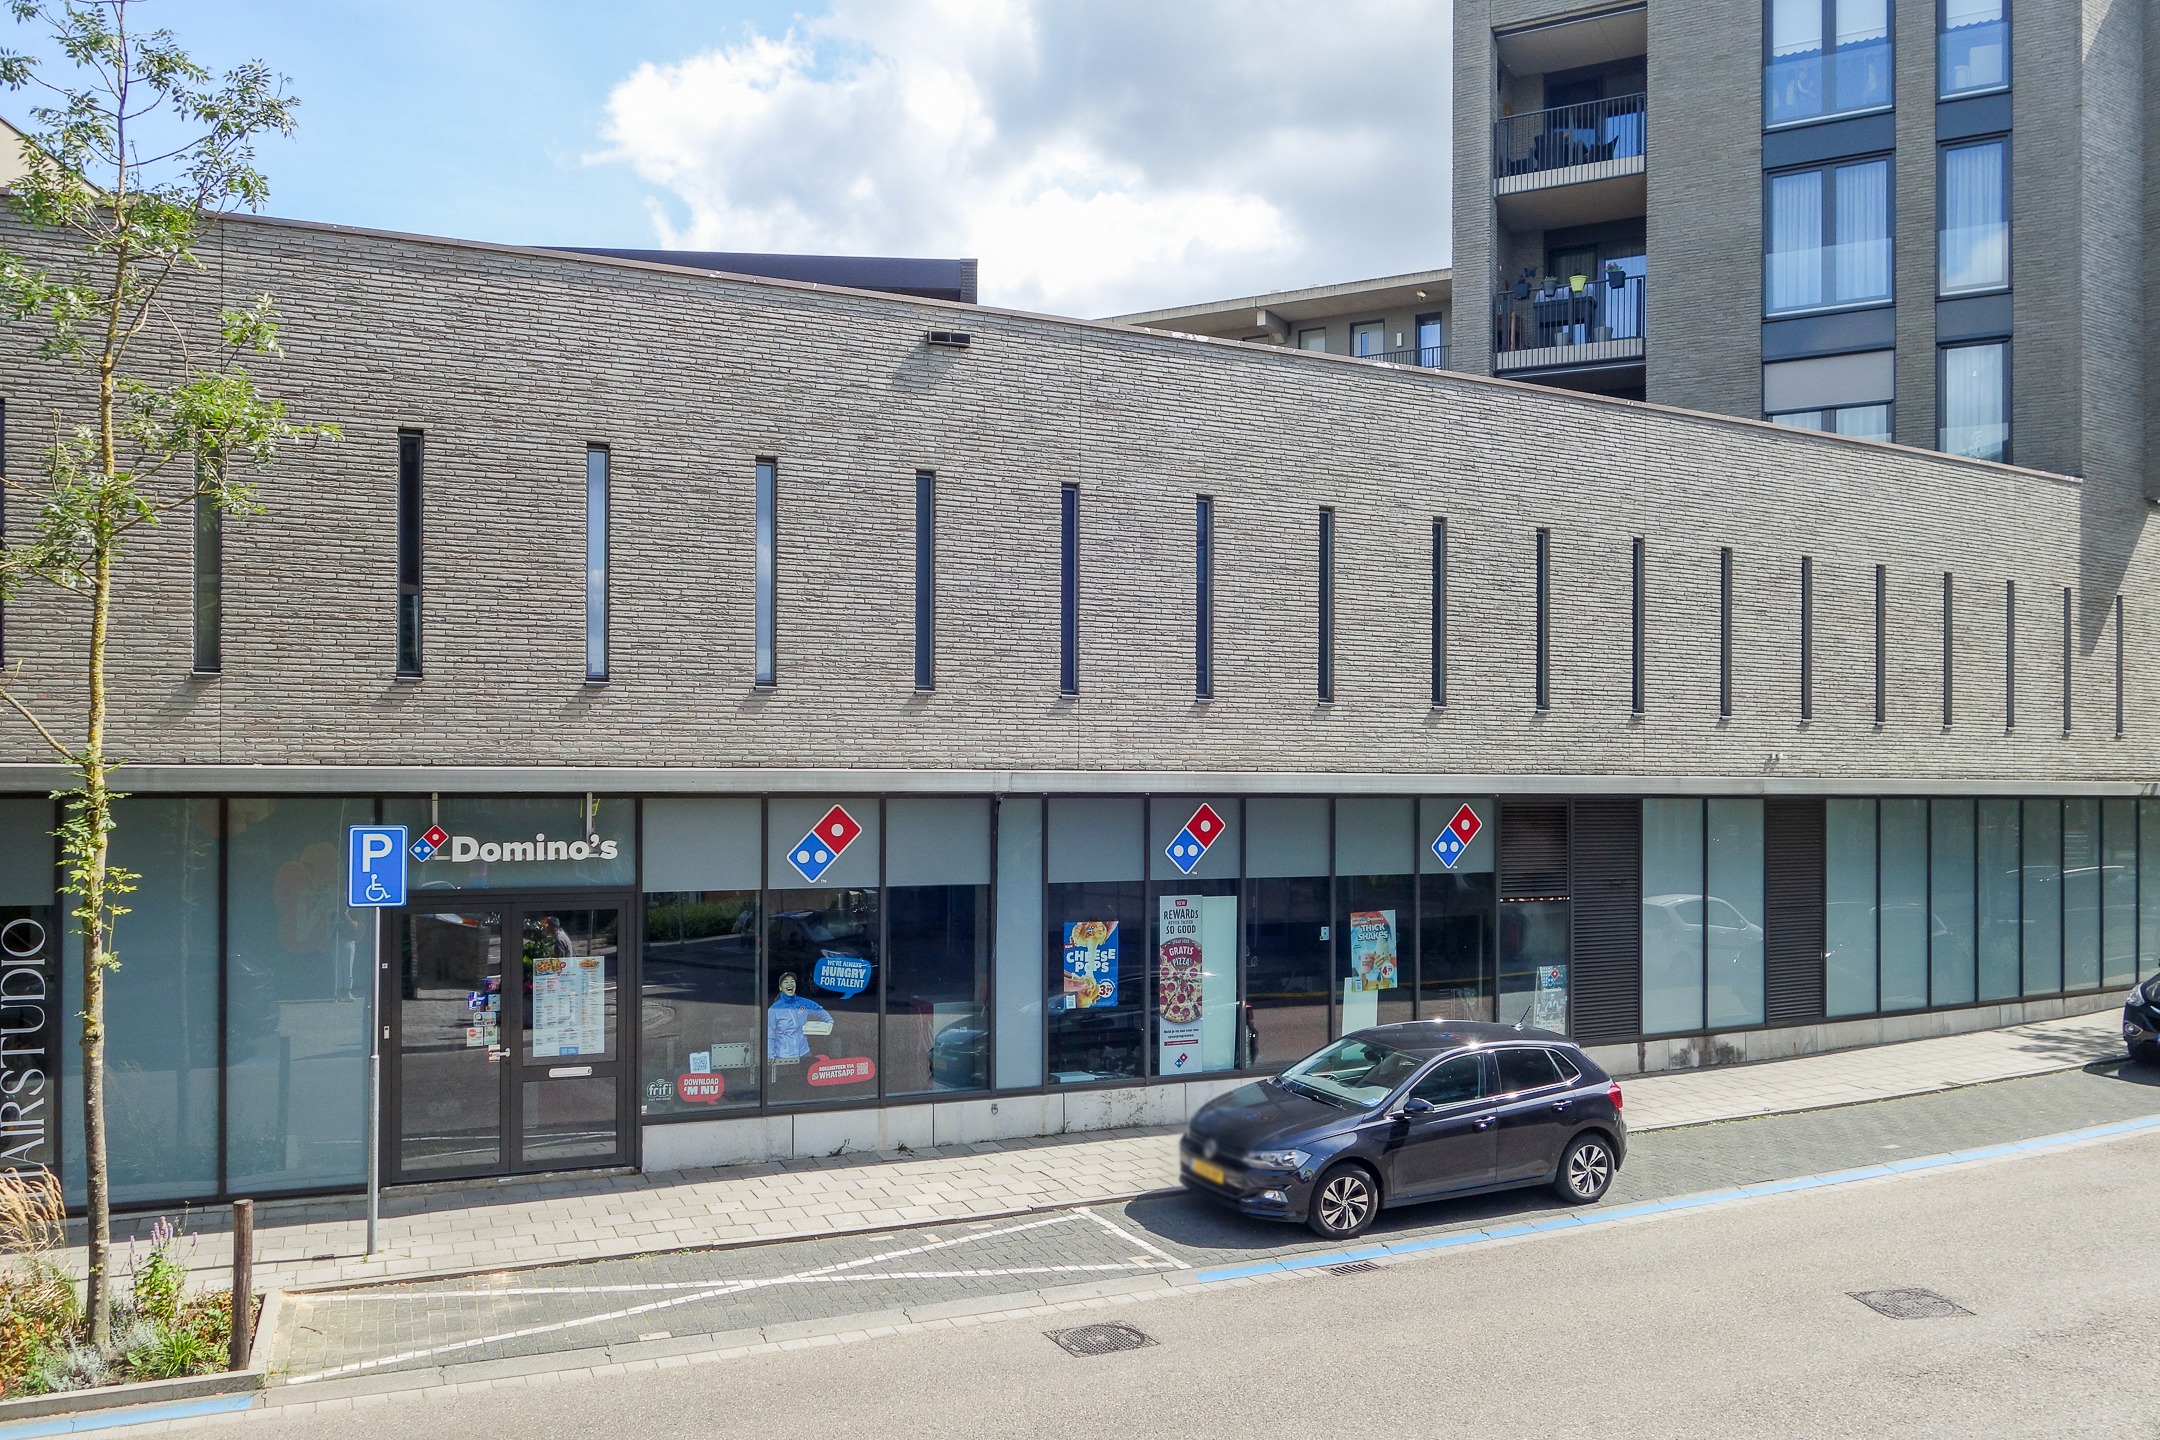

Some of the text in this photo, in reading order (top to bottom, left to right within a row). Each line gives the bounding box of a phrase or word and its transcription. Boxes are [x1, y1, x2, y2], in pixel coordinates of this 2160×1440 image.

[452, 833, 618, 862] Domino's
[362, 833, 393, 873] P
[1164, 909, 1198, 920] REWARDS
[1166, 925, 1196, 934] SO GOOD
[1361, 923, 1385, 931] THICK
[1169, 946, 1194, 956] GRATIS
[821, 966, 866, 978] HUNGRY
[820, 976, 864, 988] FOR TALENT
[819, 1069, 855, 1079] WHATSAPP
[684, 1078, 719, 1086] DOWNLOAD
[649, 1084, 672, 1096] frifi
[700, 1085, 719, 1095] NU
